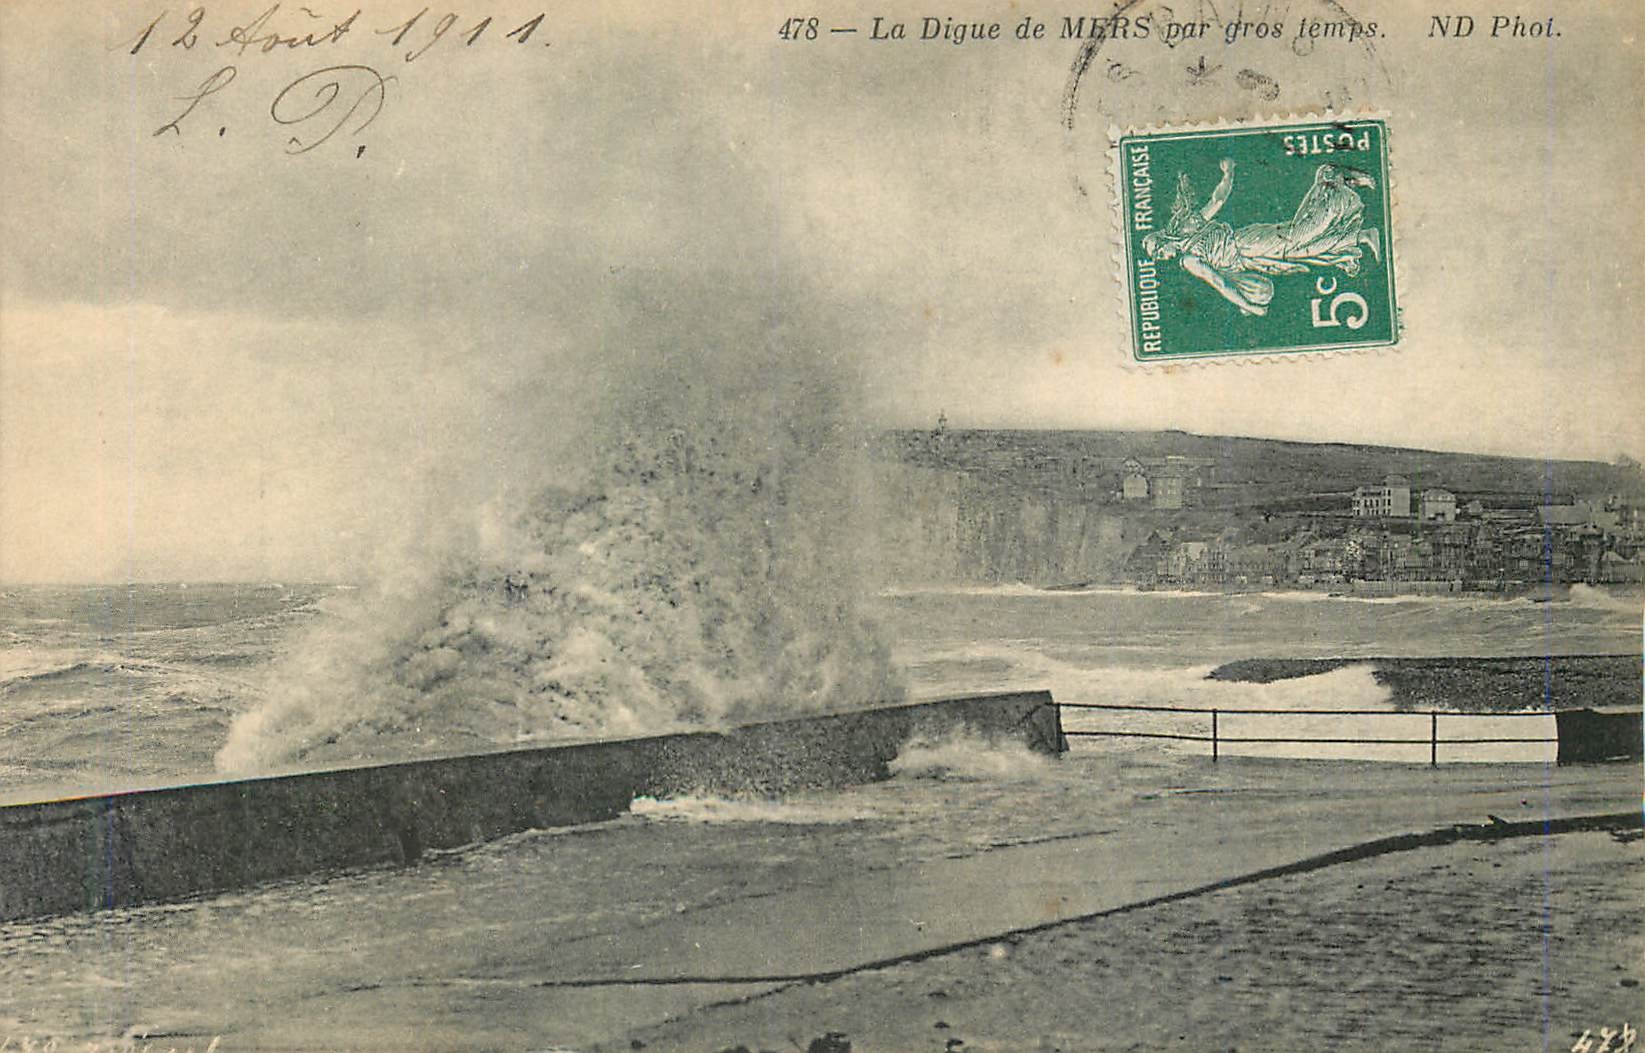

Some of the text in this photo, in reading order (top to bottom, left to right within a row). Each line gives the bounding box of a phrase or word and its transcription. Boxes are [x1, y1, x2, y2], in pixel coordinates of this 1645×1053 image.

[128, 8, 204, 54] 12
[1283, 130, 1371, 156] POSTES
[1130, 145, 1153, 231] FRANÇAISE
